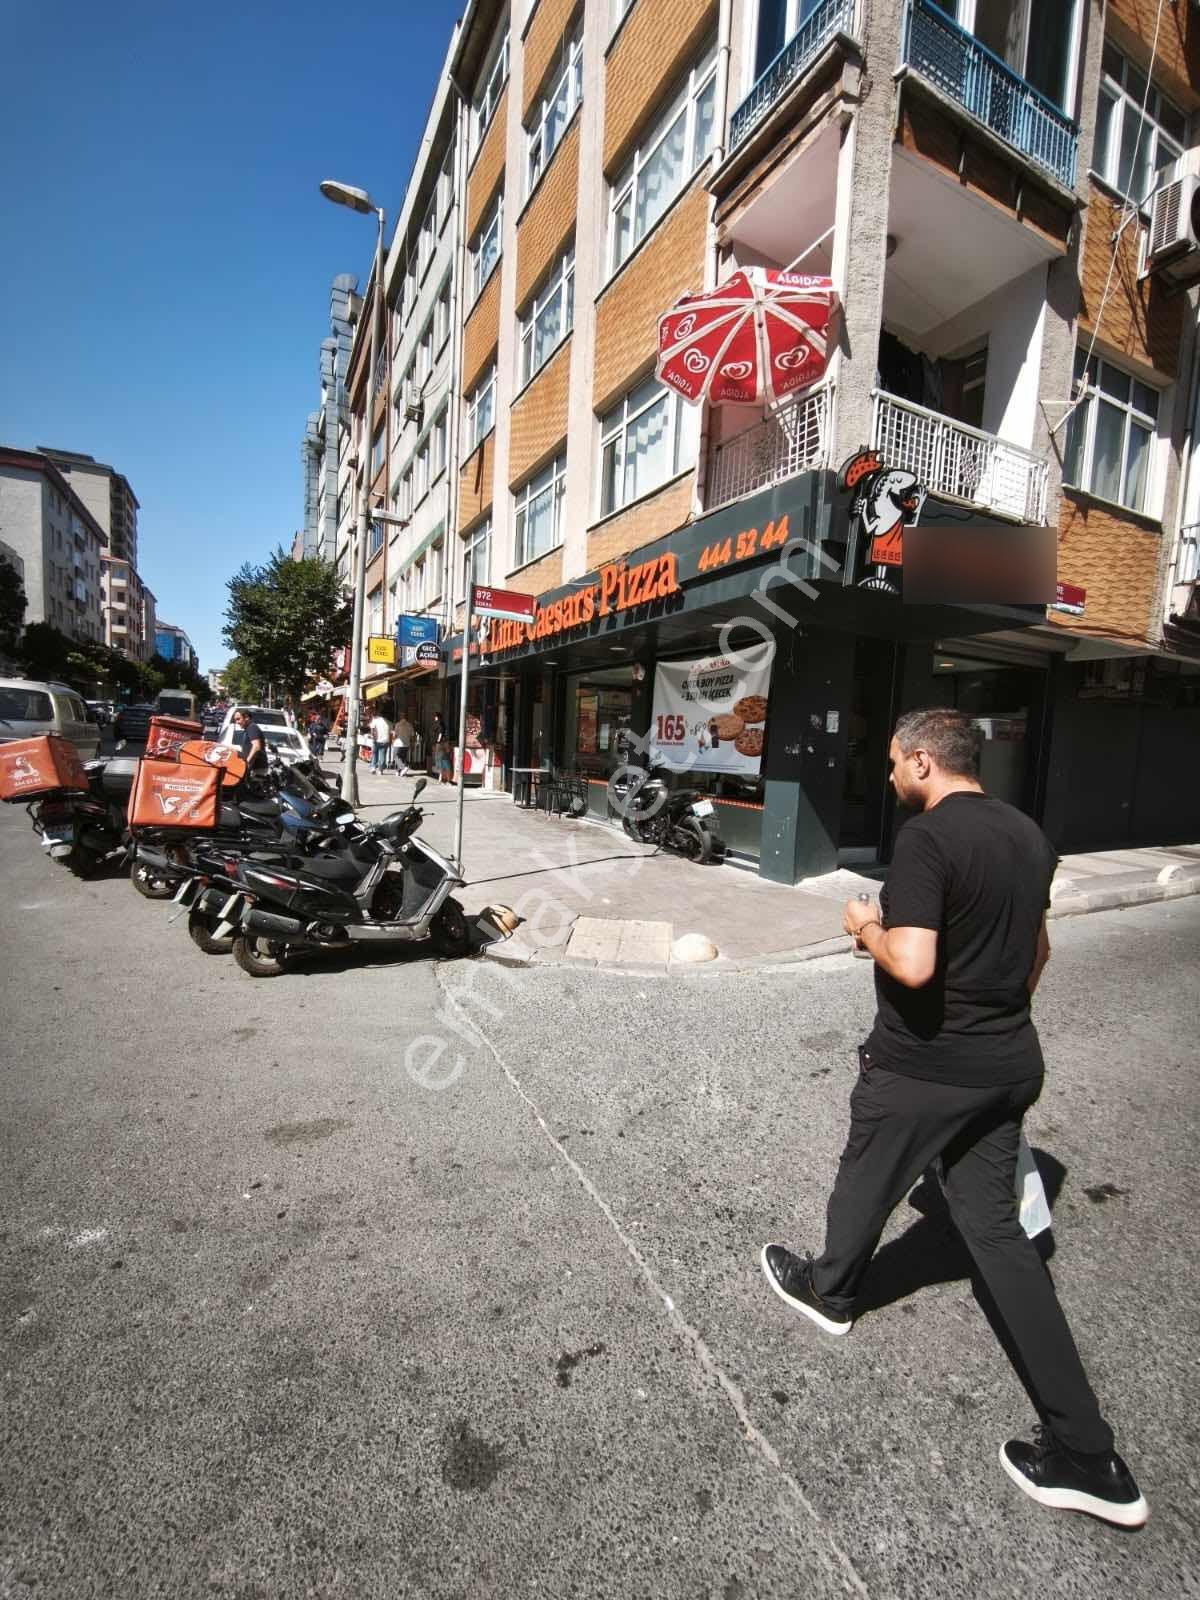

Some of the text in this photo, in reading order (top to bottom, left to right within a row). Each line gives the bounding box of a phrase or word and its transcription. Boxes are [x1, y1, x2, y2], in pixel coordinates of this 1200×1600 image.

[776, 274, 823, 286] ALGIDA
[697, 513, 789, 572] 444 52 44
[600, 551, 678, 617] Pizza
[656, 715, 685, 741] 165
